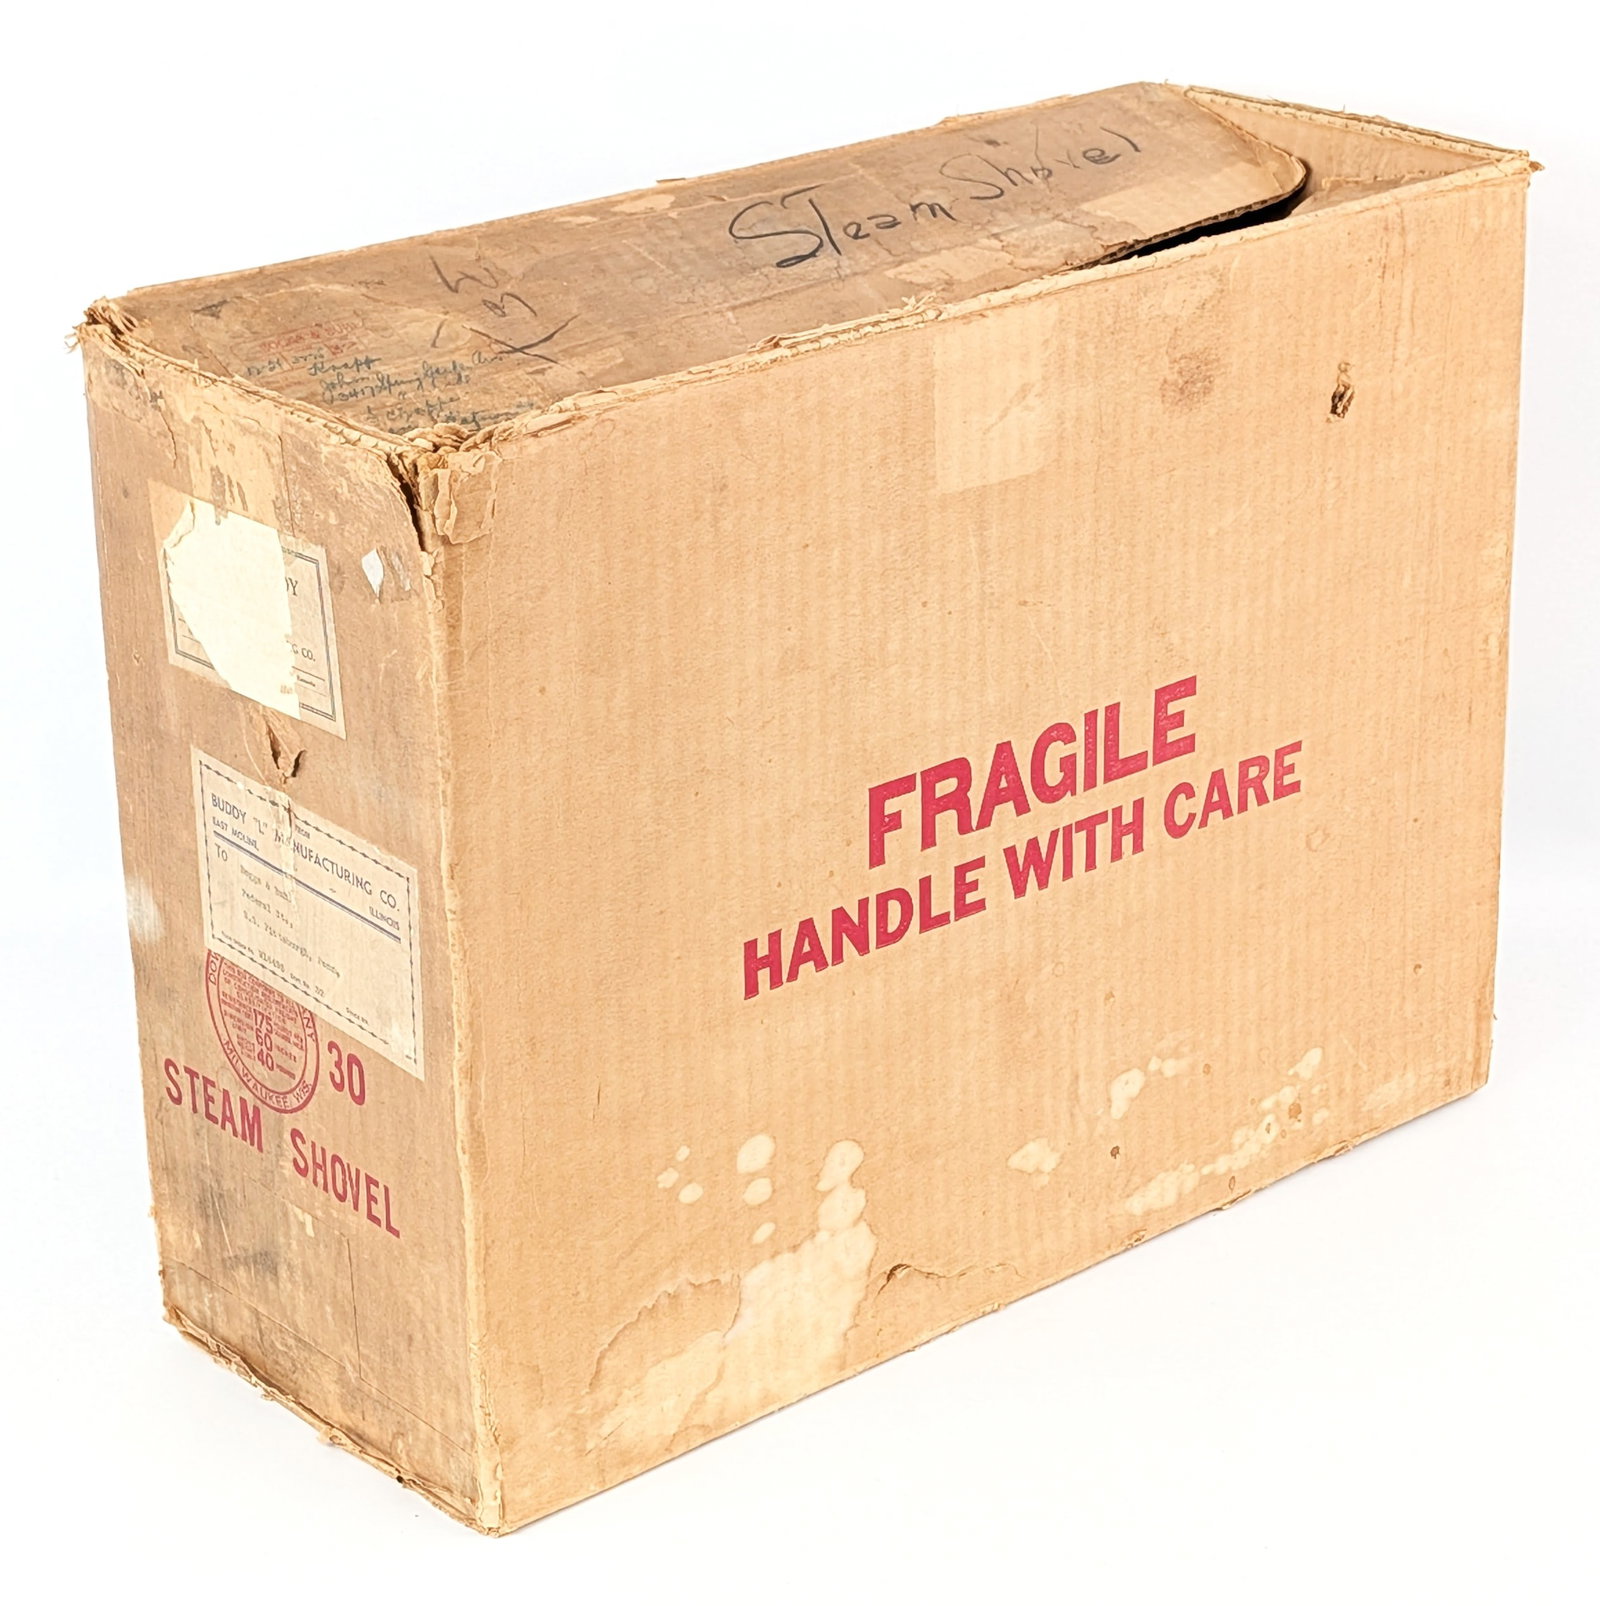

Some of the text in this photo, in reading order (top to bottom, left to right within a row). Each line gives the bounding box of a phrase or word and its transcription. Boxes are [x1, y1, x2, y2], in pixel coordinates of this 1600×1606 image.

[868, 675, 1197, 870] FRAGILE
[211, 792, 247, 825] BUDDY
[379, 889, 400, 912] CO.
[212, 815, 229, 832] EAST
[368, 905, 400, 932] ILLINOIS
[743, 740, 1303, 1000] HANDLE WITH CARE
[253, 1008, 273, 1034] 175
[255, 1027, 273, 1052] 60
[257, 1048, 274, 1072] 40
[327, 1039, 366, 1106] 30
[164, 1057, 400, 1239] STEAM SHOVEL
